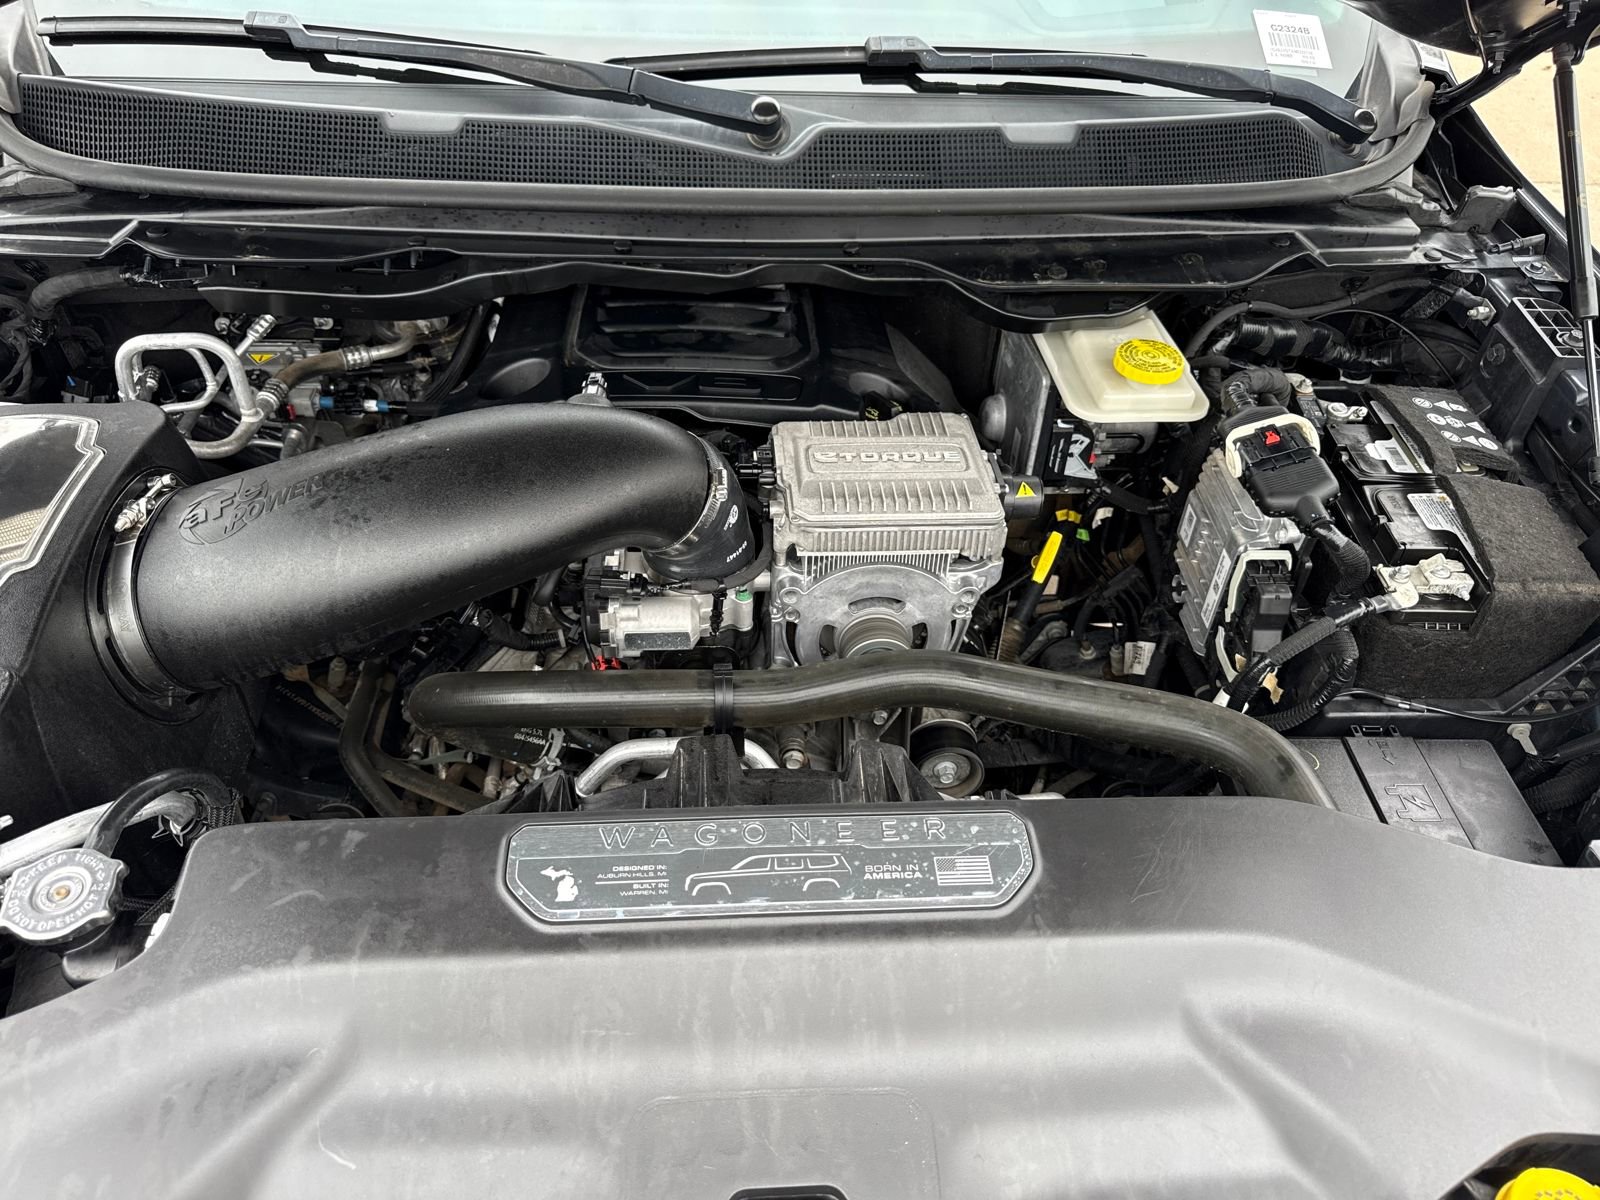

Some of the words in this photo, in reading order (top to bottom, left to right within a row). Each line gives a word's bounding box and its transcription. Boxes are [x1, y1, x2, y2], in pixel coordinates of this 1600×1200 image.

[224, 472, 324, 534] POWER
[599, 817, 946, 849] WAGONEER
[31, 854, 67, 877] KEEP
[75, 853, 105, 872] TIGHT
[863, 871, 923, 880] AMERICA
[865, 864, 902, 873] BORN
[906, 863, 919, 871] IN
[8, 899, 21, 916] DO
[15, 912, 38, 931] NOT
[36, 914, 75, 932] OPEN
[76, 894, 98, 916] HOT
